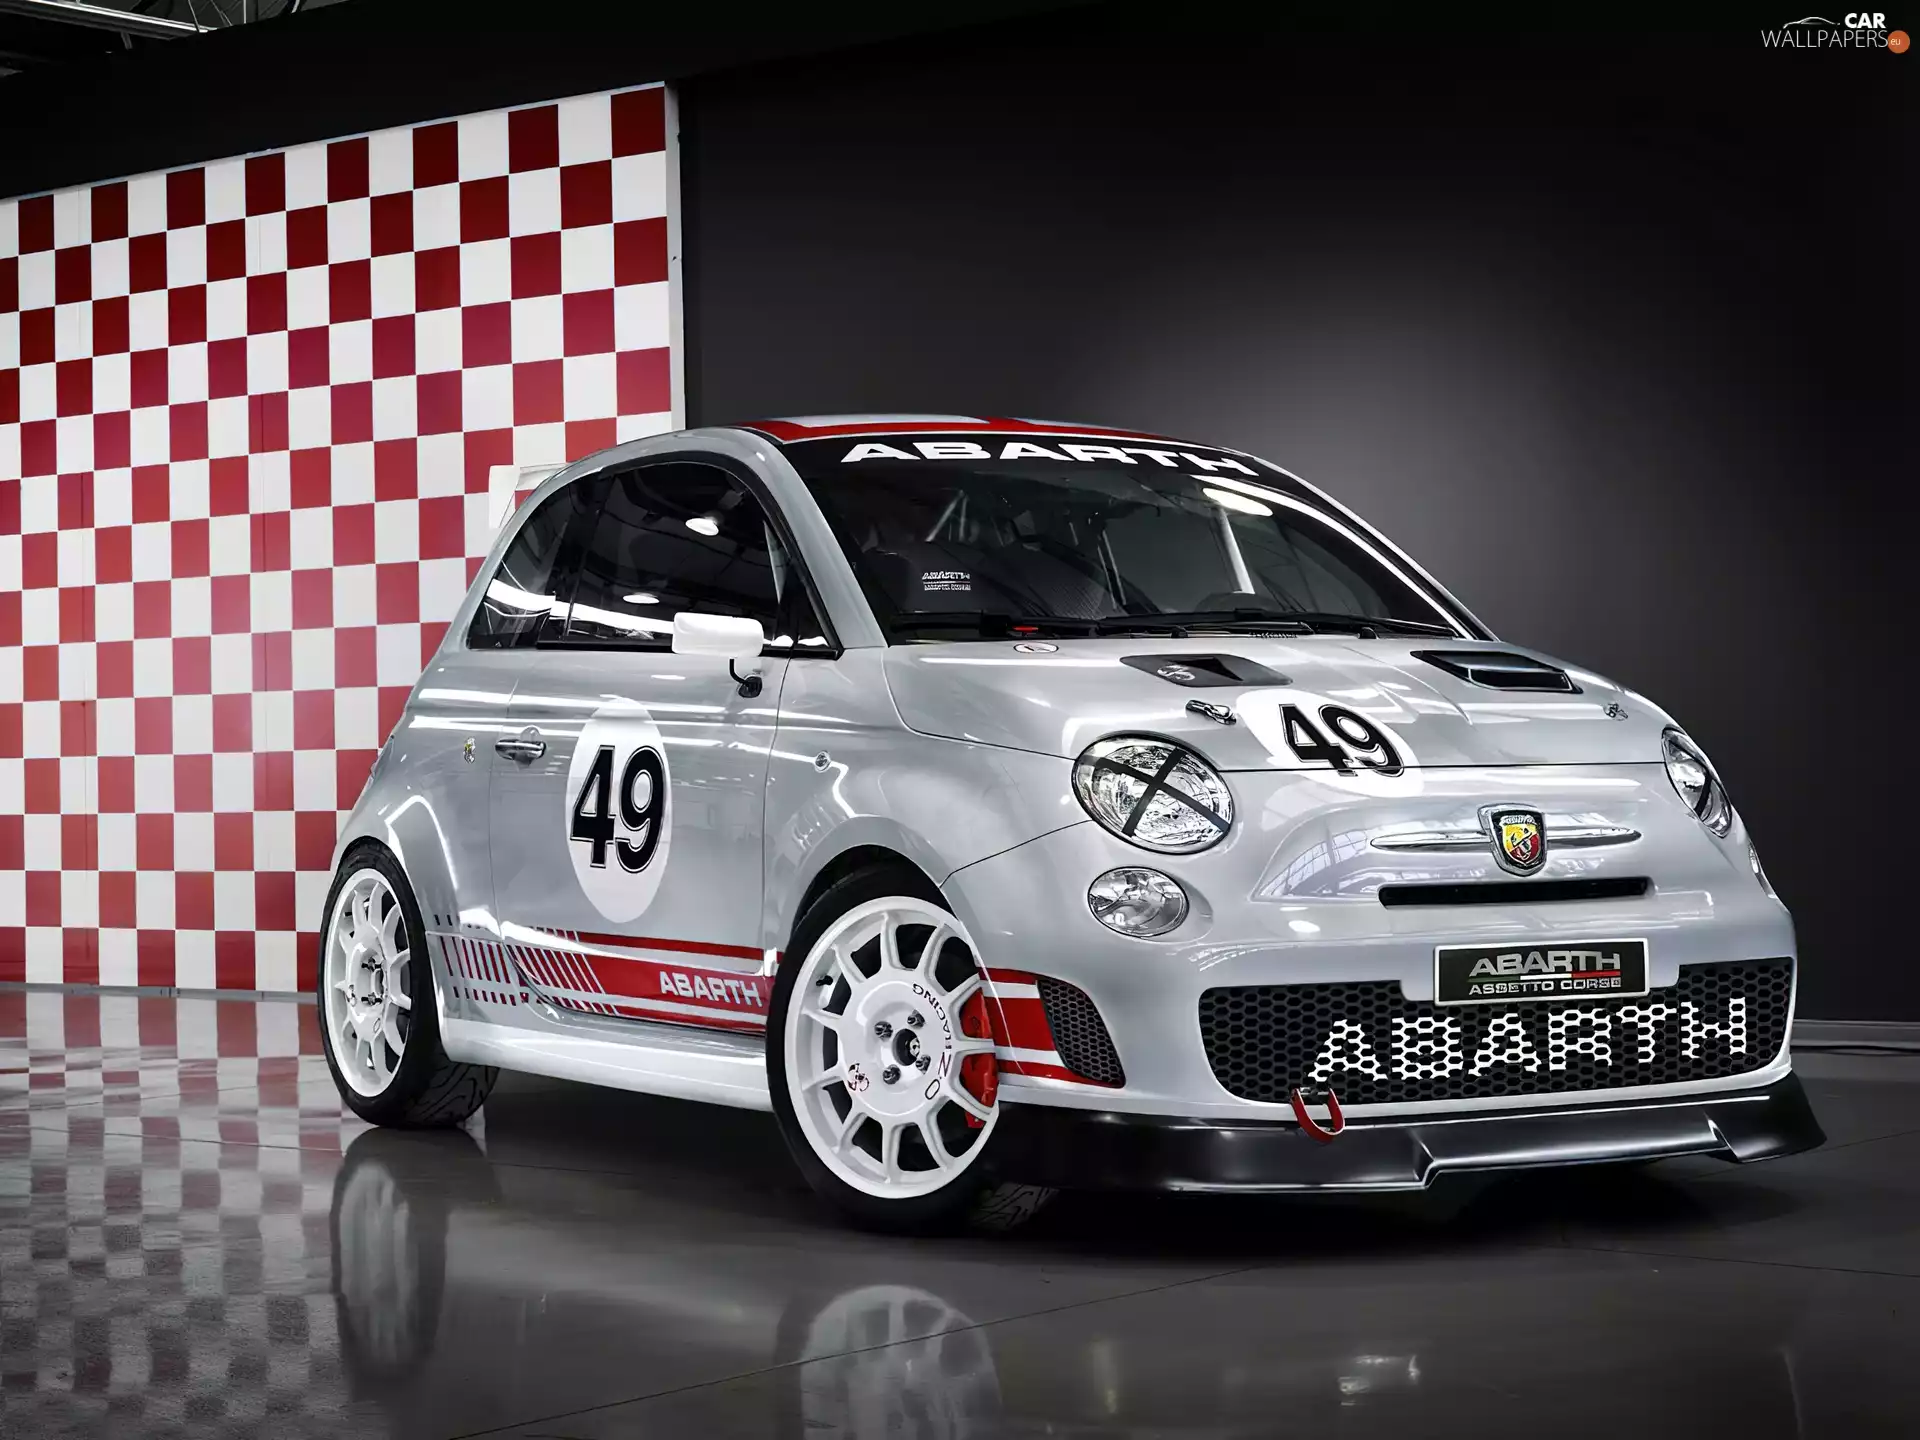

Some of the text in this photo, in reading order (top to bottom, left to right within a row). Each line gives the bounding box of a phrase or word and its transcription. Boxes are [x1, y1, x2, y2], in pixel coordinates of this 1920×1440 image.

[840, 441, 1260, 477] ABARTH
[1278, 702, 1404, 777] 49
[570, 744, 666, 874] 49
[1468, 950, 1621, 977] ABARTH
[659, 970, 762, 1006] ABARTH
[1468, 977, 1622, 996] ASSETTO CORSE
[1306, 997, 1748, 1082] ABARTH
